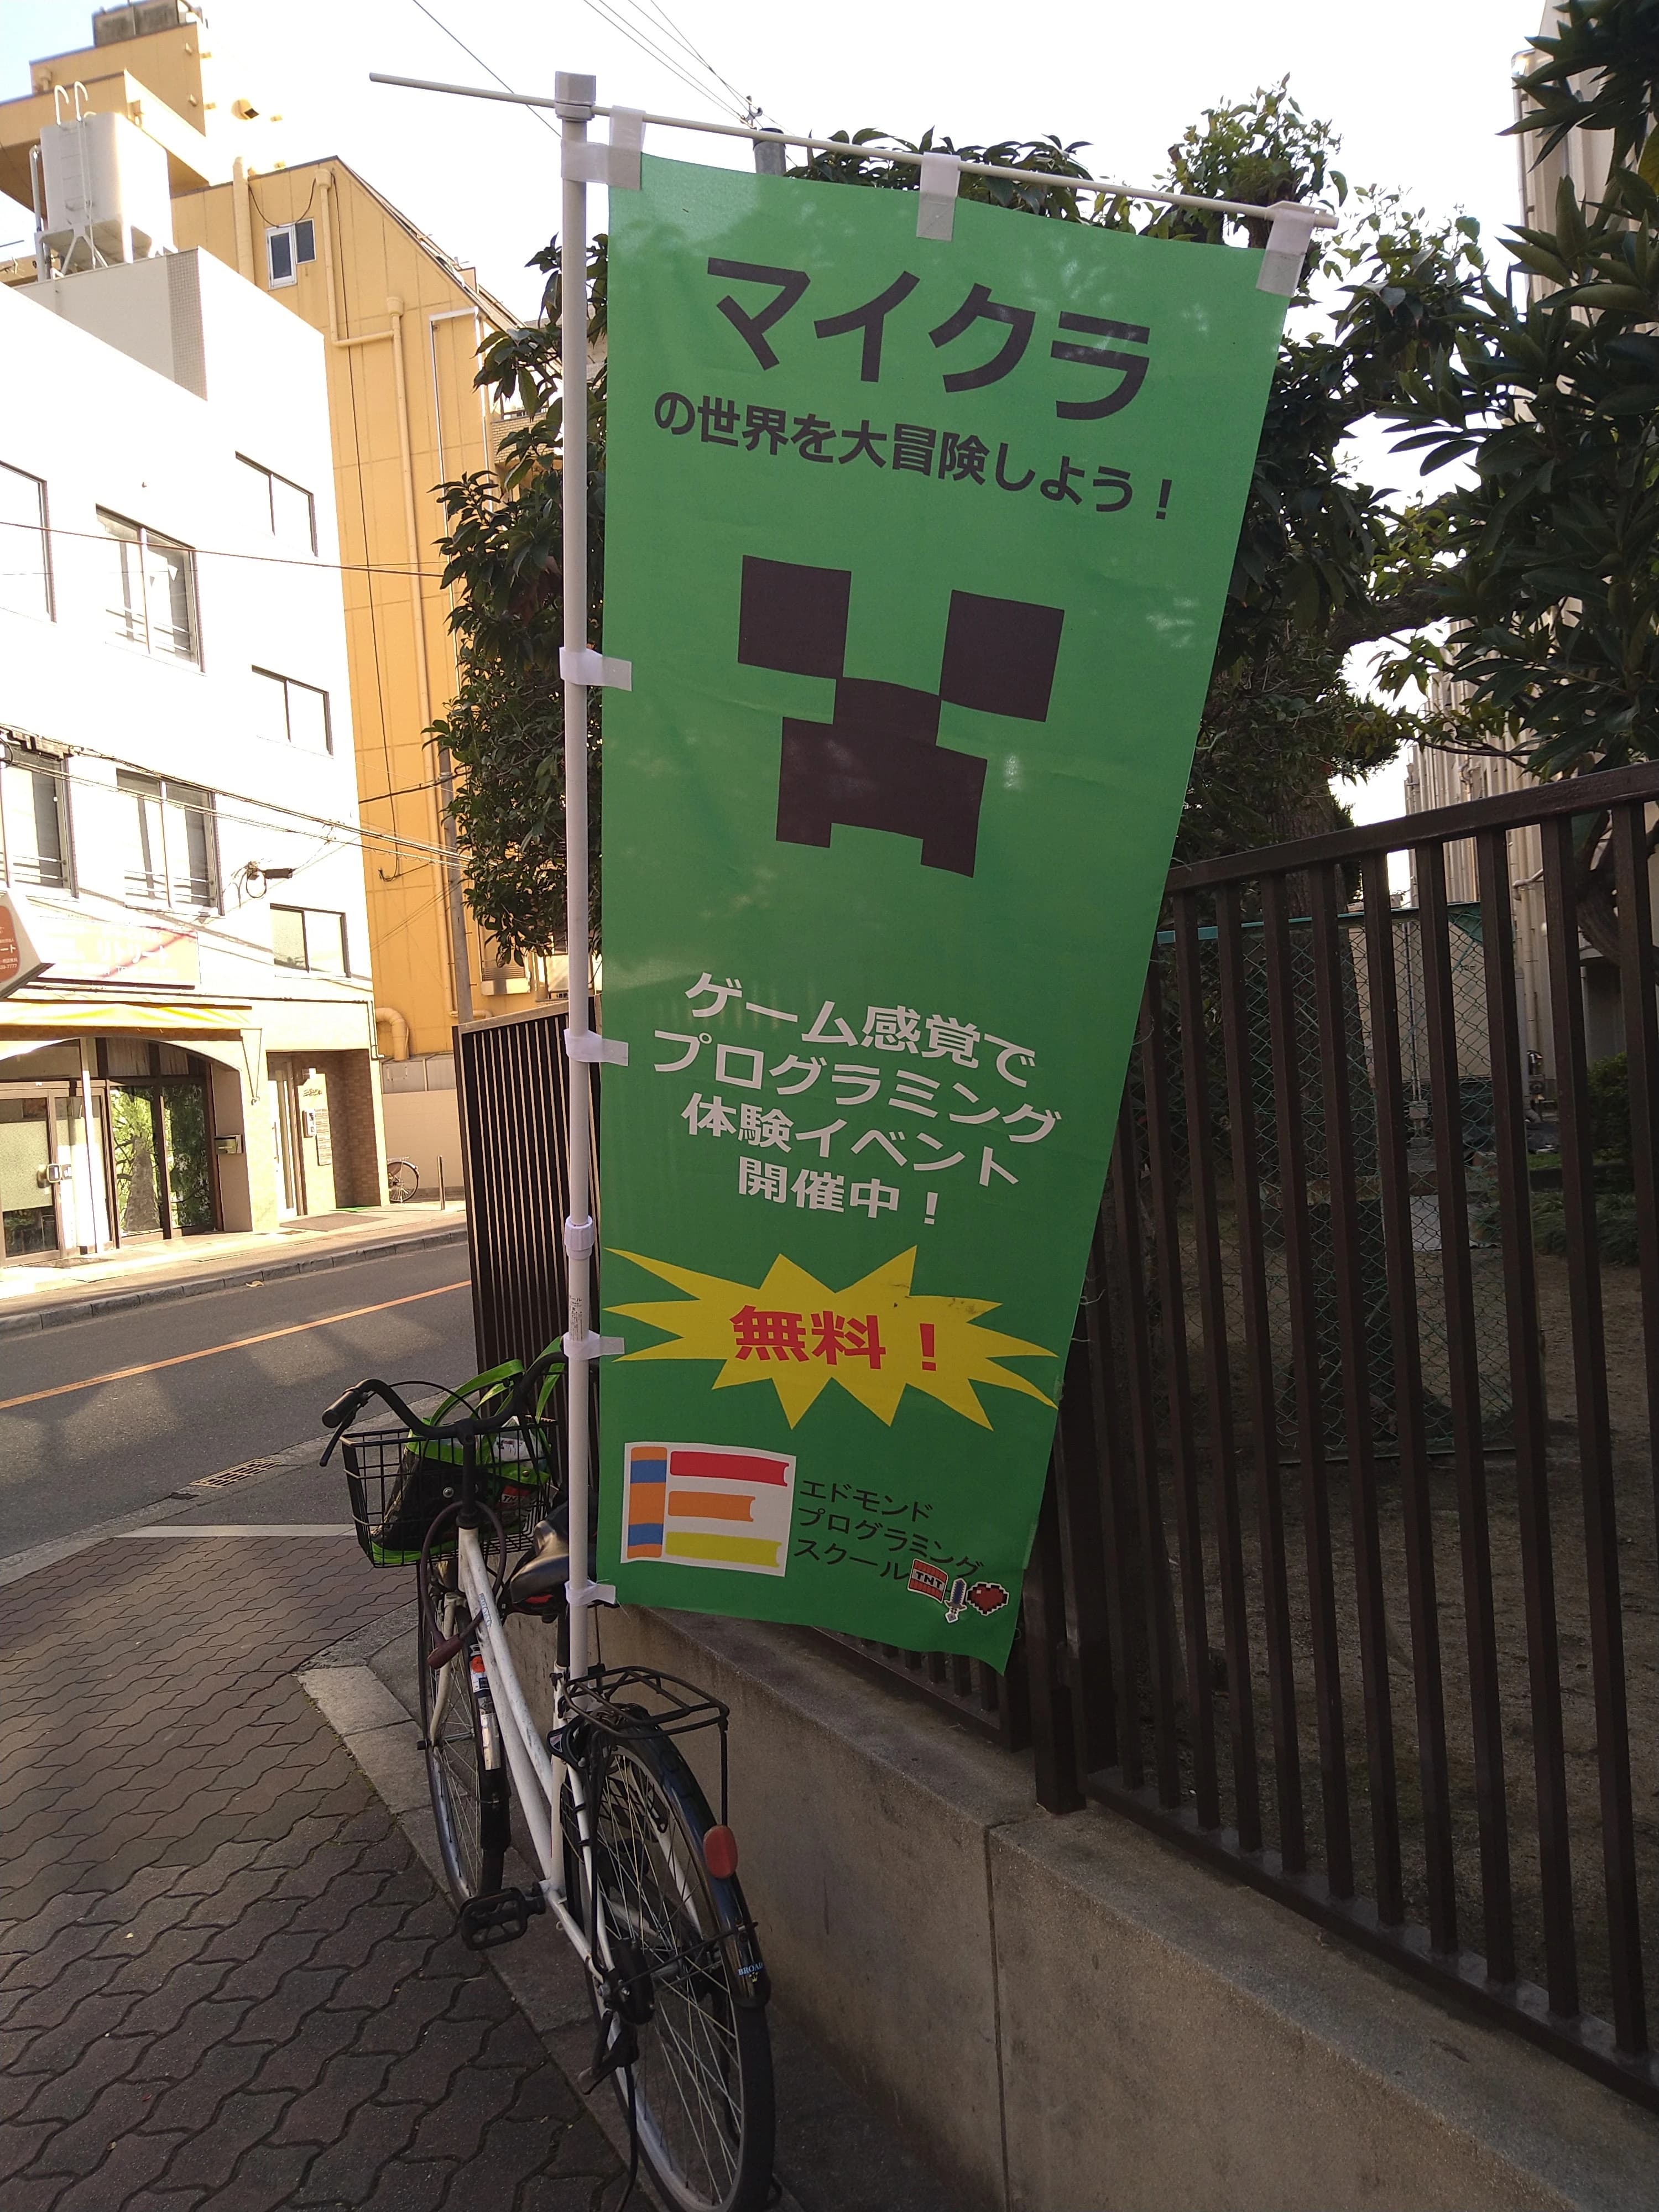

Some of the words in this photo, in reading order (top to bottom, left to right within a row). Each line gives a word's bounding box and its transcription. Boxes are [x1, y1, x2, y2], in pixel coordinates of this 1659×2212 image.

[707, 257, 1151, 421] マイクラ
[654, 392, 1173, 520] の世界を大冒険しよう！
[685, 972, 1037, 1088] ゲーム感覚で
[654, 1030, 1062, 1144] プログラミング
[681, 1093, 1019, 1187] 体験イベント
[739, 1156, 939, 1225] 開催中！
[730, 1305, 937, 1372] 無料！
[800, 1480, 933, 1522] エドモンド
[794, 1538, 910, 1580] スクール
[798, 1507, 984, 1578] プログラミング
[916, 1571, 942, 1588] TNT
